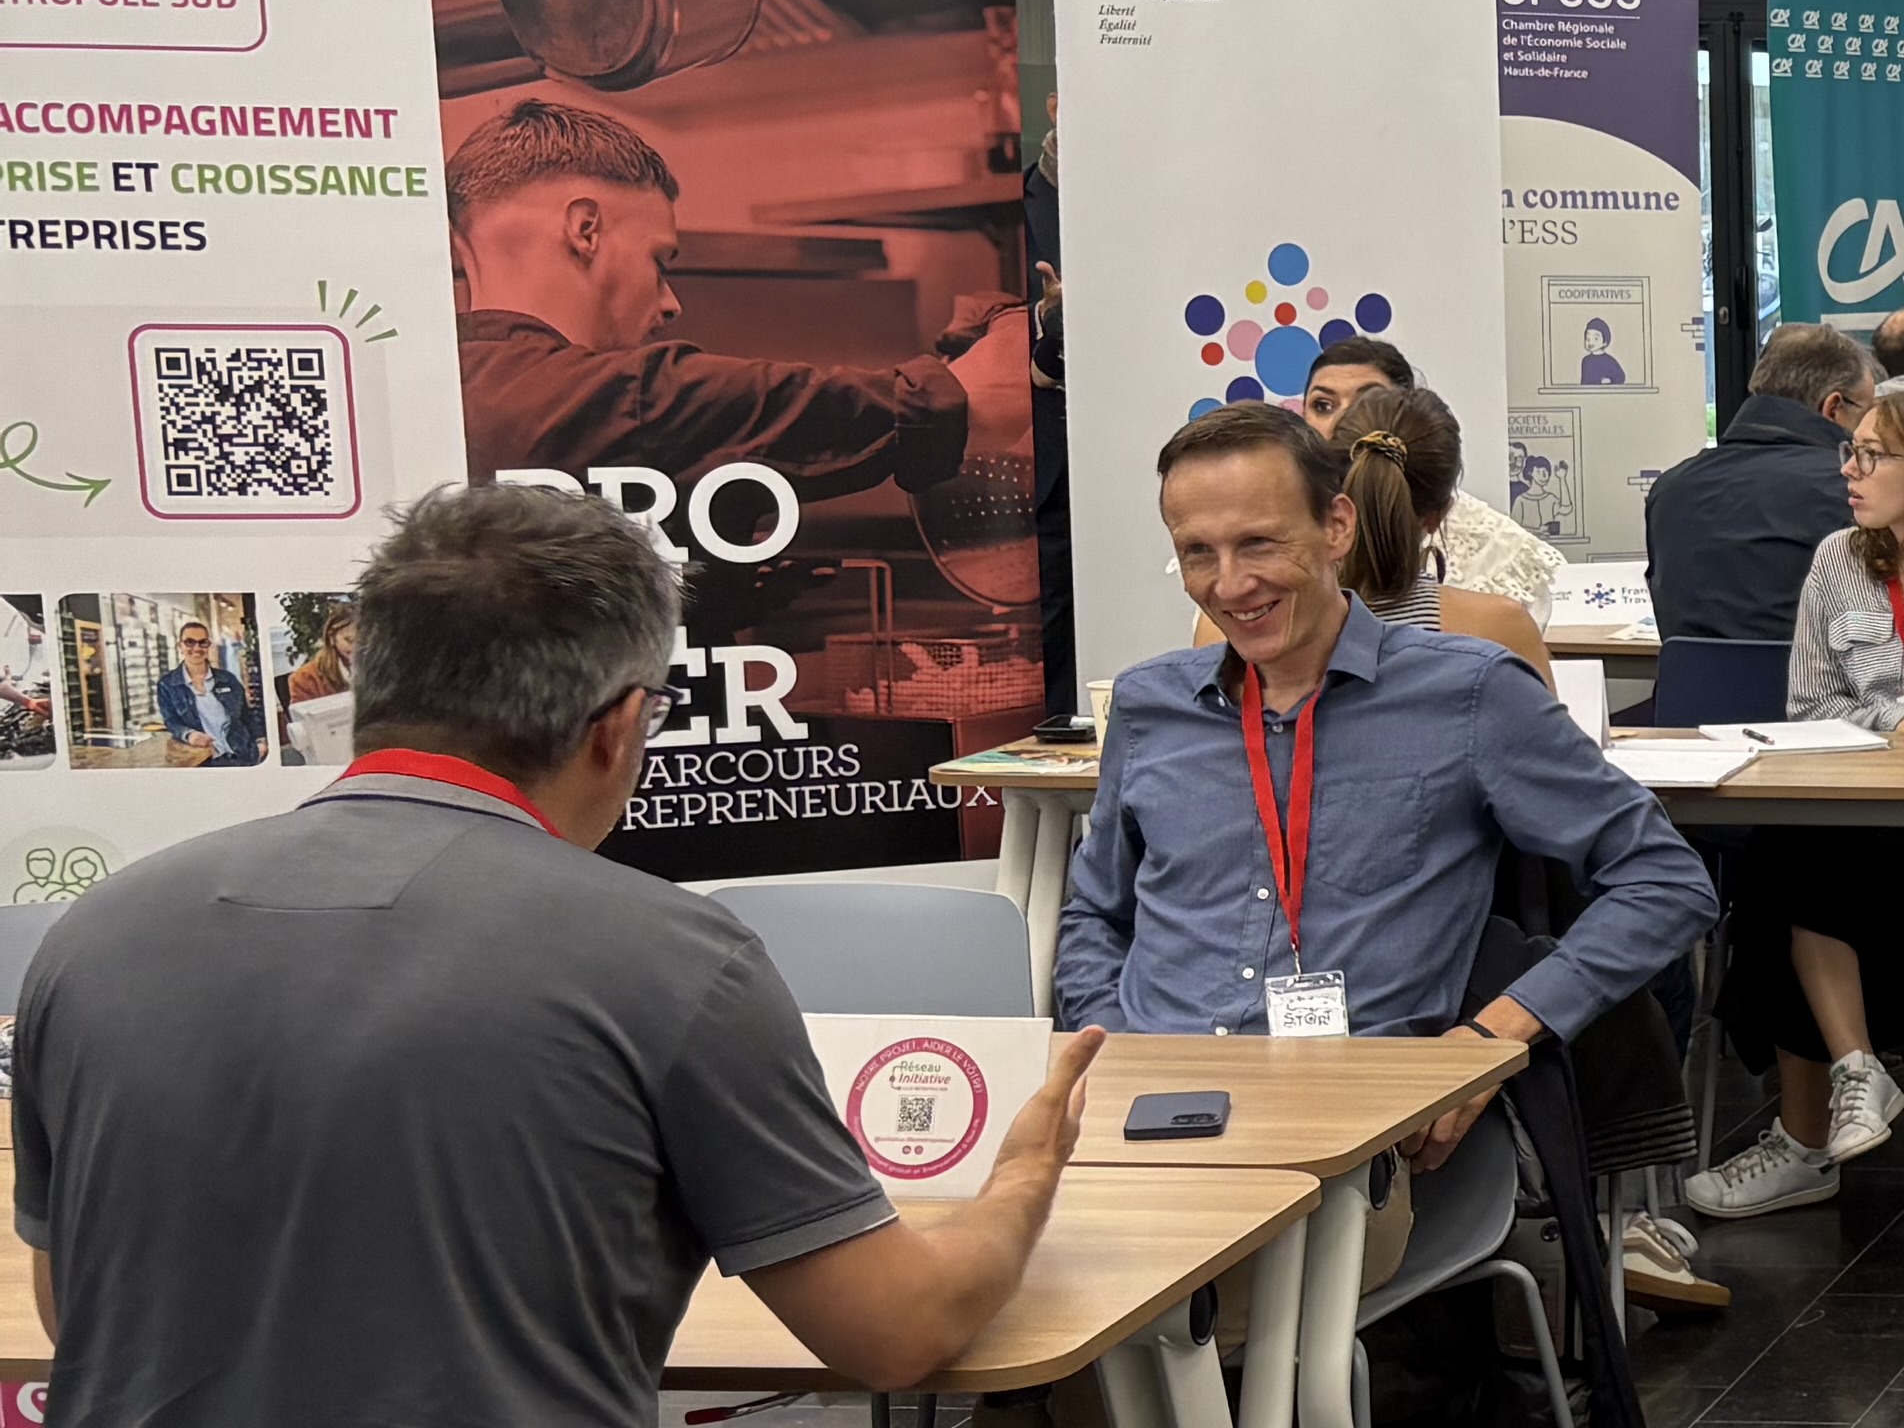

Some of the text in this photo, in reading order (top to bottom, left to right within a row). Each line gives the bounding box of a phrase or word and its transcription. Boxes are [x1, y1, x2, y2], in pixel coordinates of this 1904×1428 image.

[1098, 4, 1136, 16] Liberté
[1099, 18, 1137, 32] Égalité
[1502, 18, 1615, 35] Chambre Régionale
[1100, 33, 1153, 45] Fraternité
[1503, 34, 1627, 50] de l'Économie Sociale
[1503, 50, 1567, 63] et Solidaire
[1504, 66, 1588, 78] Hauts-de-France
[0, 160, 428, 197] RISE ET CROISSANCE
[1523, 188, 1680, 211] commune
[0, 219, 207, 251] REPRISES
[922, 1040, 952, 1056] AIDER
[900, 1061, 941, 1073] Réseau
[898, 1073, 951, 1085] Initiative
